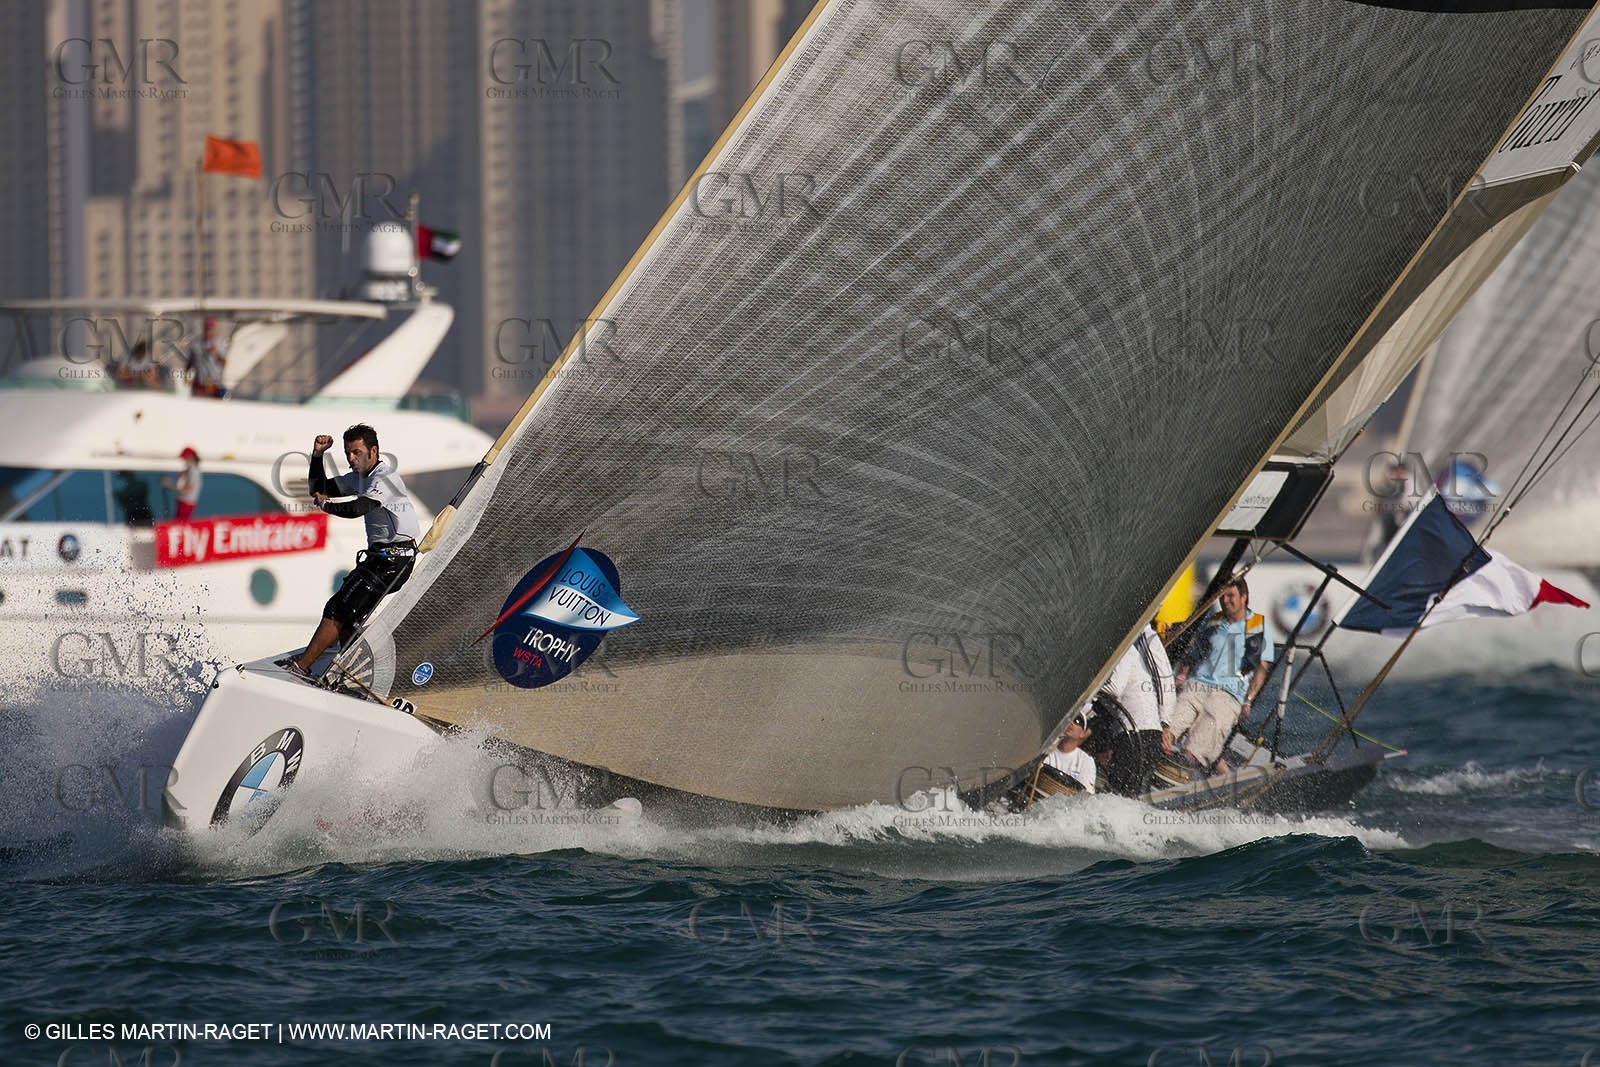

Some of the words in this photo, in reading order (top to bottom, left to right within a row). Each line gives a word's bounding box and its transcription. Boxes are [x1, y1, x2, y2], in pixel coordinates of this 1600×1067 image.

[168, 525, 210, 561] Fly
[213, 518, 319, 554] Emirates
[560, 568, 606, 598] LOUIS
[549, 587, 612, 626] VUITTON
[513, 647, 543, 668] WSTA
[523, 626, 581, 663] TROPHY
[250, 730, 302, 774] BMW
